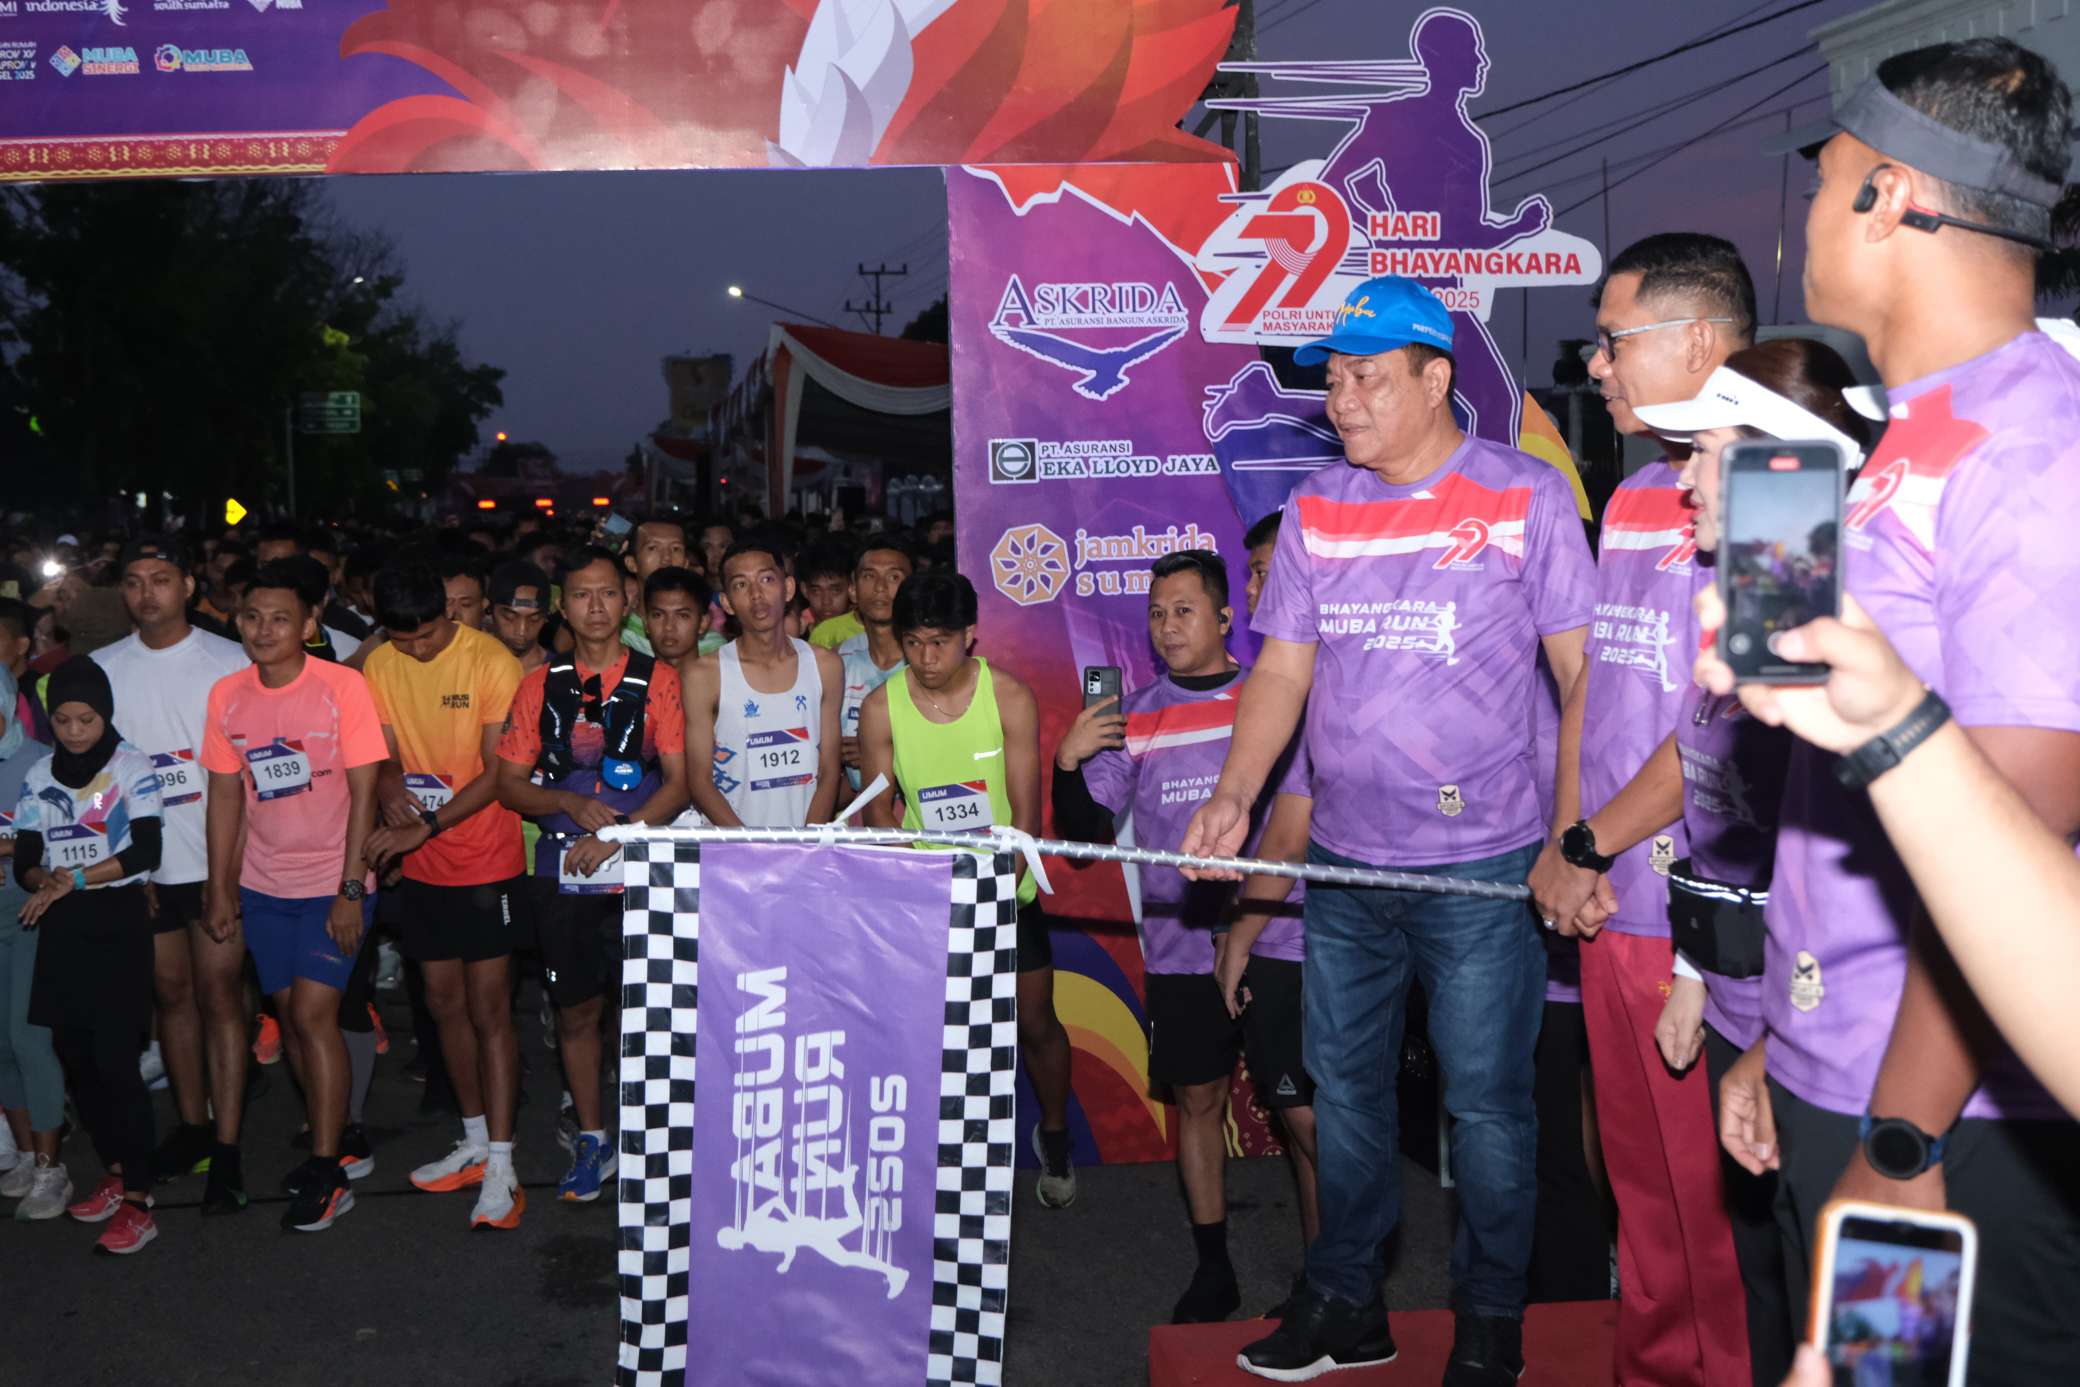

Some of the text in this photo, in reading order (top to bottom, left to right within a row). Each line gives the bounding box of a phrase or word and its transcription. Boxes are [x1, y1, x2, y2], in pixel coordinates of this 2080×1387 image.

[82, 47, 138, 63] MUBA
[184, 49, 250, 65] MUBA
[1369, 213, 1439, 238] HARI
[1369, 251, 1582, 275] BHAYANGKARA
[992, 274, 1186, 326] ASKRIDA
[1059, 316, 1105, 327] ASURANSI
[1106, 315, 1145, 326] BANGUN
[1146, 315, 1187, 325] ASKRIDA
[1262, 310, 1336, 321] POLRI UNT
[1262, 321, 1334, 332] MASYARAK
[1064, 442, 1131, 455] ASURANSI
[1042, 456, 1219, 477] EKA LLOYD JAYA
[1074, 525, 1217, 570] jamkrida
[1075, 571, 1153, 596] sum
[1319, 614, 1428, 634] MUBA RUN
[1363, 635, 1416, 651] 2025
[1600, 645, 1636, 664] 2025
[750, 735, 774, 746] UMUM
[760, 749, 801, 769] 1912
[264, 760, 302, 780] 1839
[1161, 774, 1220, 791] BHAYANG
[921, 788, 948, 800] UMUM
[1161, 787, 1212, 806] MUBA
[935, 801, 980, 823] 1334
[62, 843, 99, 862] 1115
